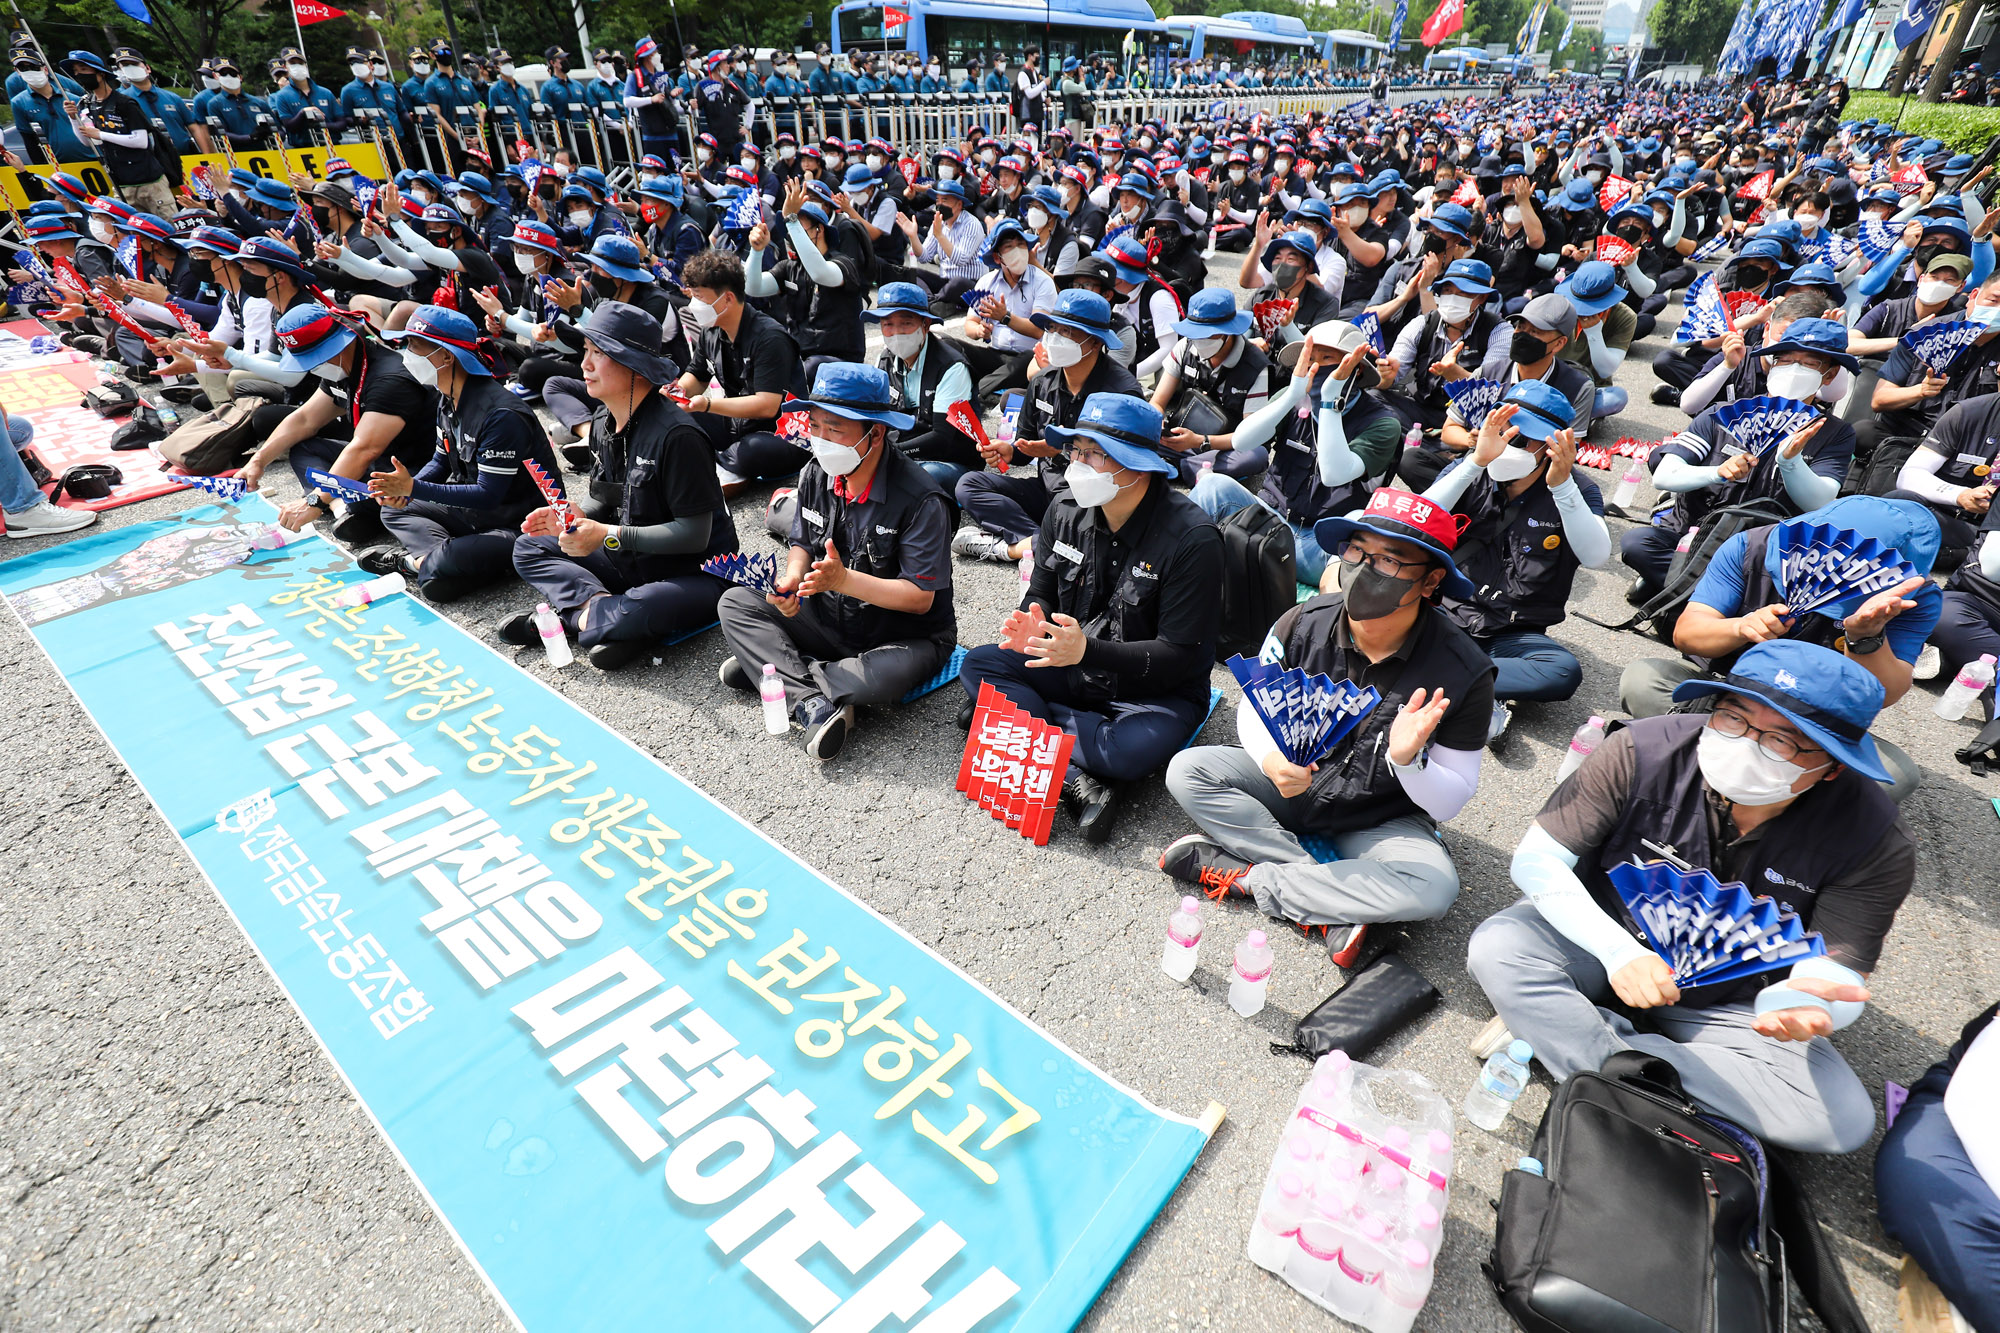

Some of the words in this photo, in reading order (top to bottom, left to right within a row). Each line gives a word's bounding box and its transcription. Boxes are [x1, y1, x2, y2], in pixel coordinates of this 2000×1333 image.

[297, 4, 330, 17] 42기-2
[1391, 496, 1434, 524] 투쟁
[153, 602, 358, 737] 조선산업
[264, 709, 443, 820] 근본
[239, 822, 435, 1041] 전국금속노동조합
[268, 574, 370, 638] 정부는
[332, 624, 495, 721] 조선하청
[437, 703, 598, 807] 노동자
[550, 786, 769, 961] 생존권을
[726, 926, 1042, 1185] 보장하고
[349, 788, 604, 990] 대책을
[509, 945, 1021, 1333] 마련하라
